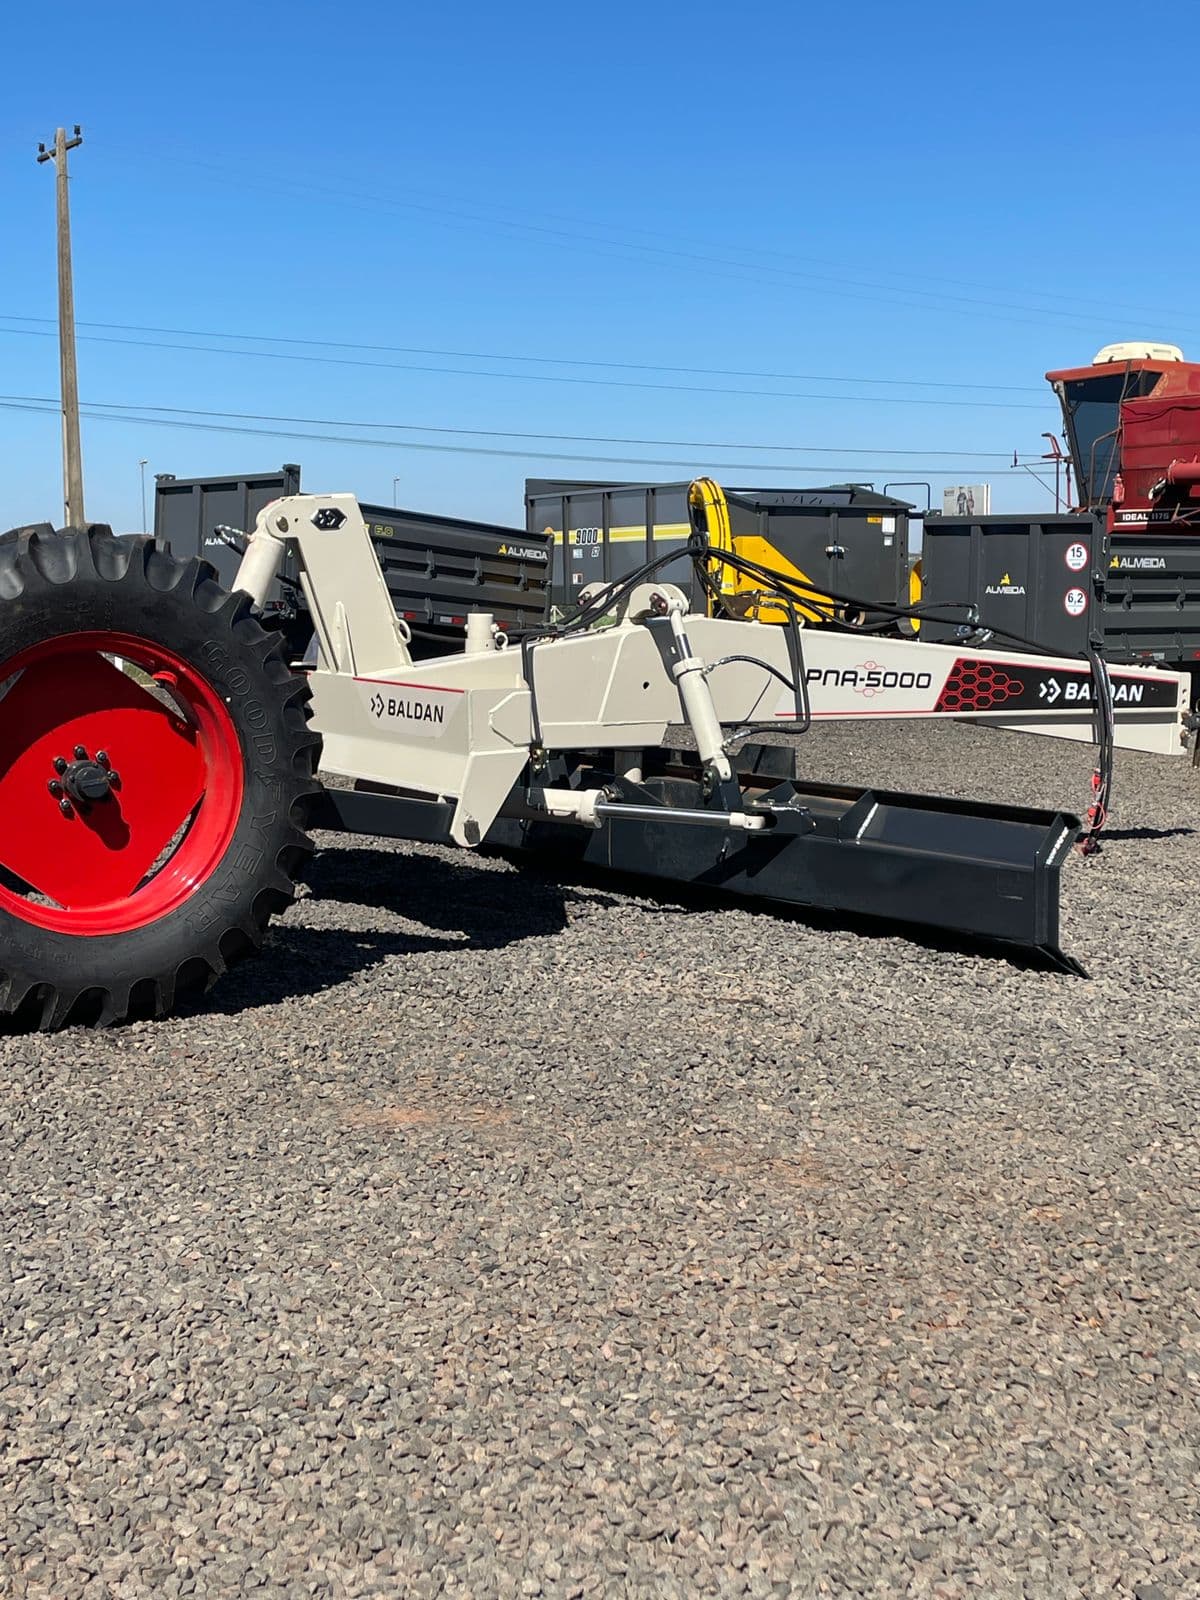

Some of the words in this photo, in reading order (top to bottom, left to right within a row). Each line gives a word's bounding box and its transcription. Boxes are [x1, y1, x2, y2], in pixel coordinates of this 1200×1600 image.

[575, 528, 599, 545] 9000
[1071, 547, 1083, 558] 15
[806, 669, 932, 688] PNA-5000
[387, 698, 444, 723] BALDAN
